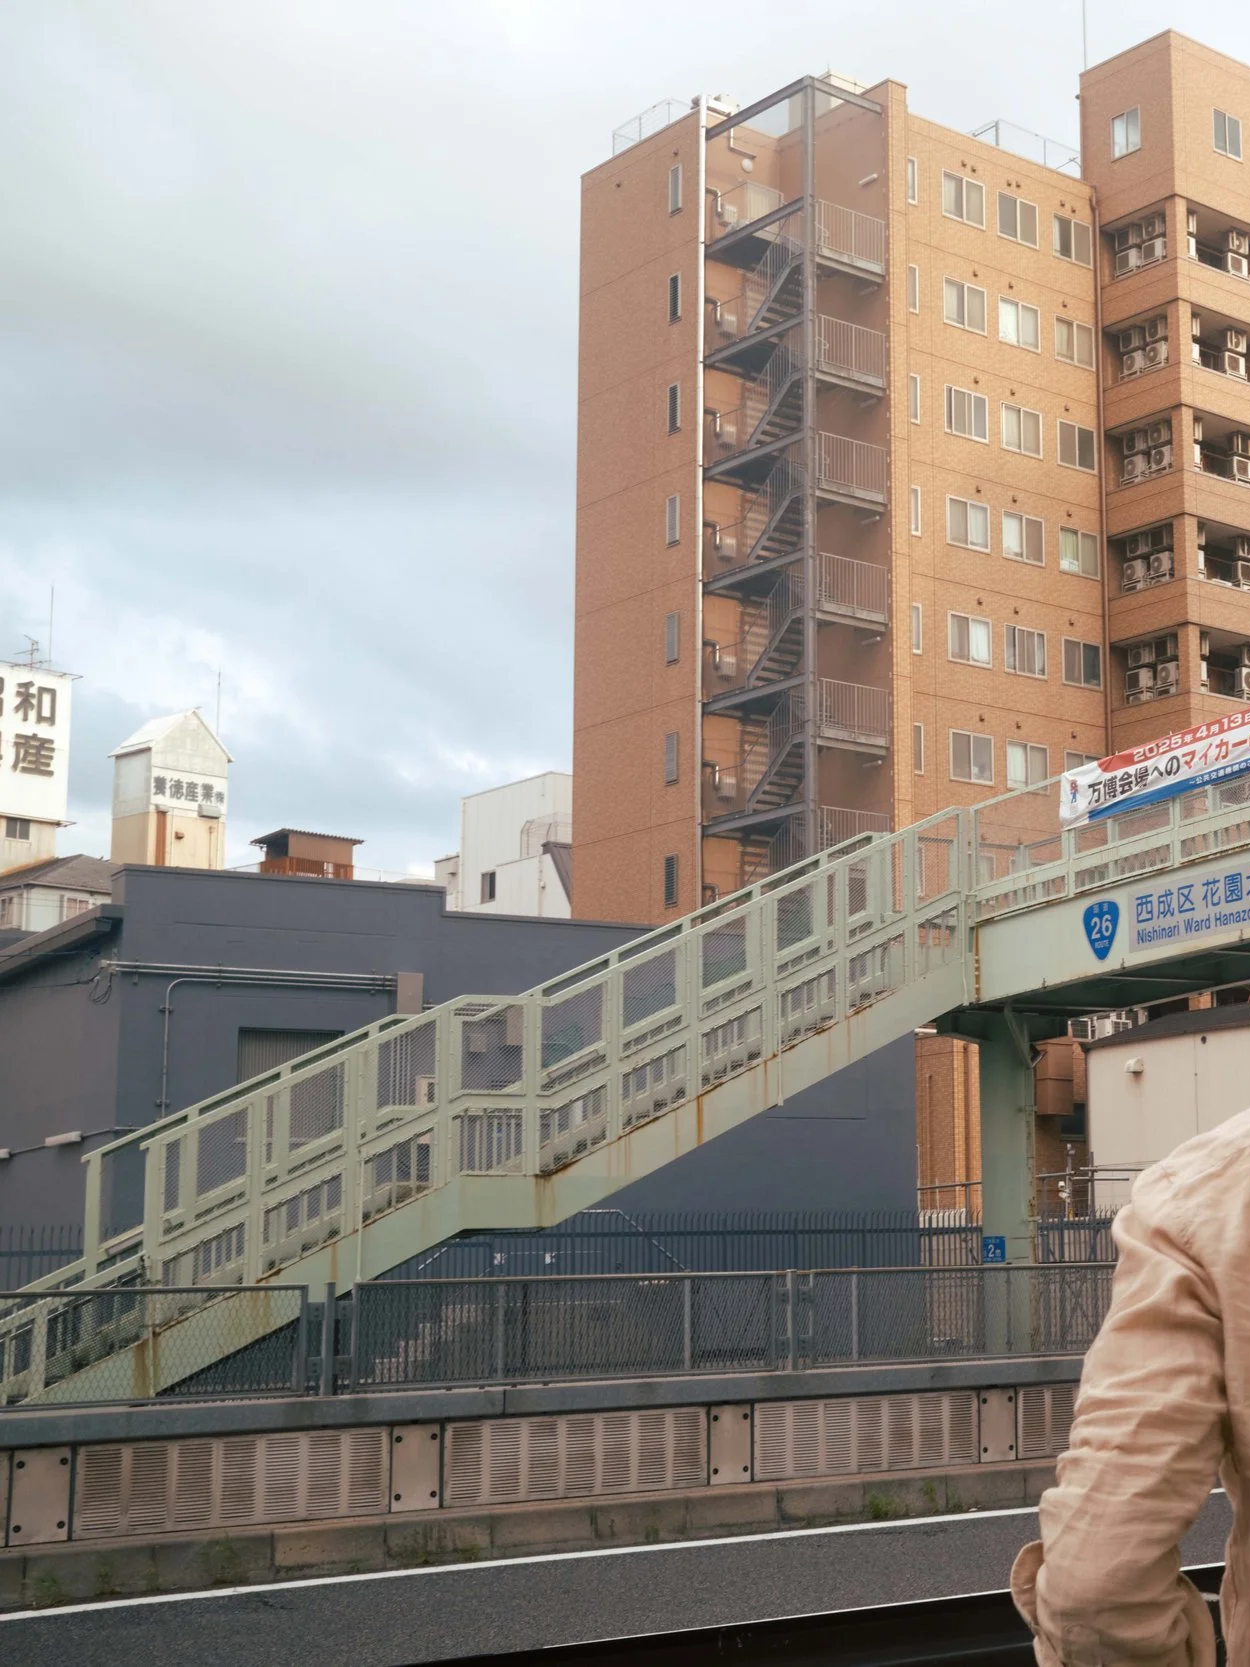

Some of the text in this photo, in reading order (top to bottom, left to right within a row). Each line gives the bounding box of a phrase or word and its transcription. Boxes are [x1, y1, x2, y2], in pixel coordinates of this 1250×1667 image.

[0, 676, 57, 727] 和
[0, 730, 56, 778] 産
[1090, 914, 1113, 940] 26
[1136, 921, 1180, 945] Nishinari
[1183, 913, 1211, 934] Ward
